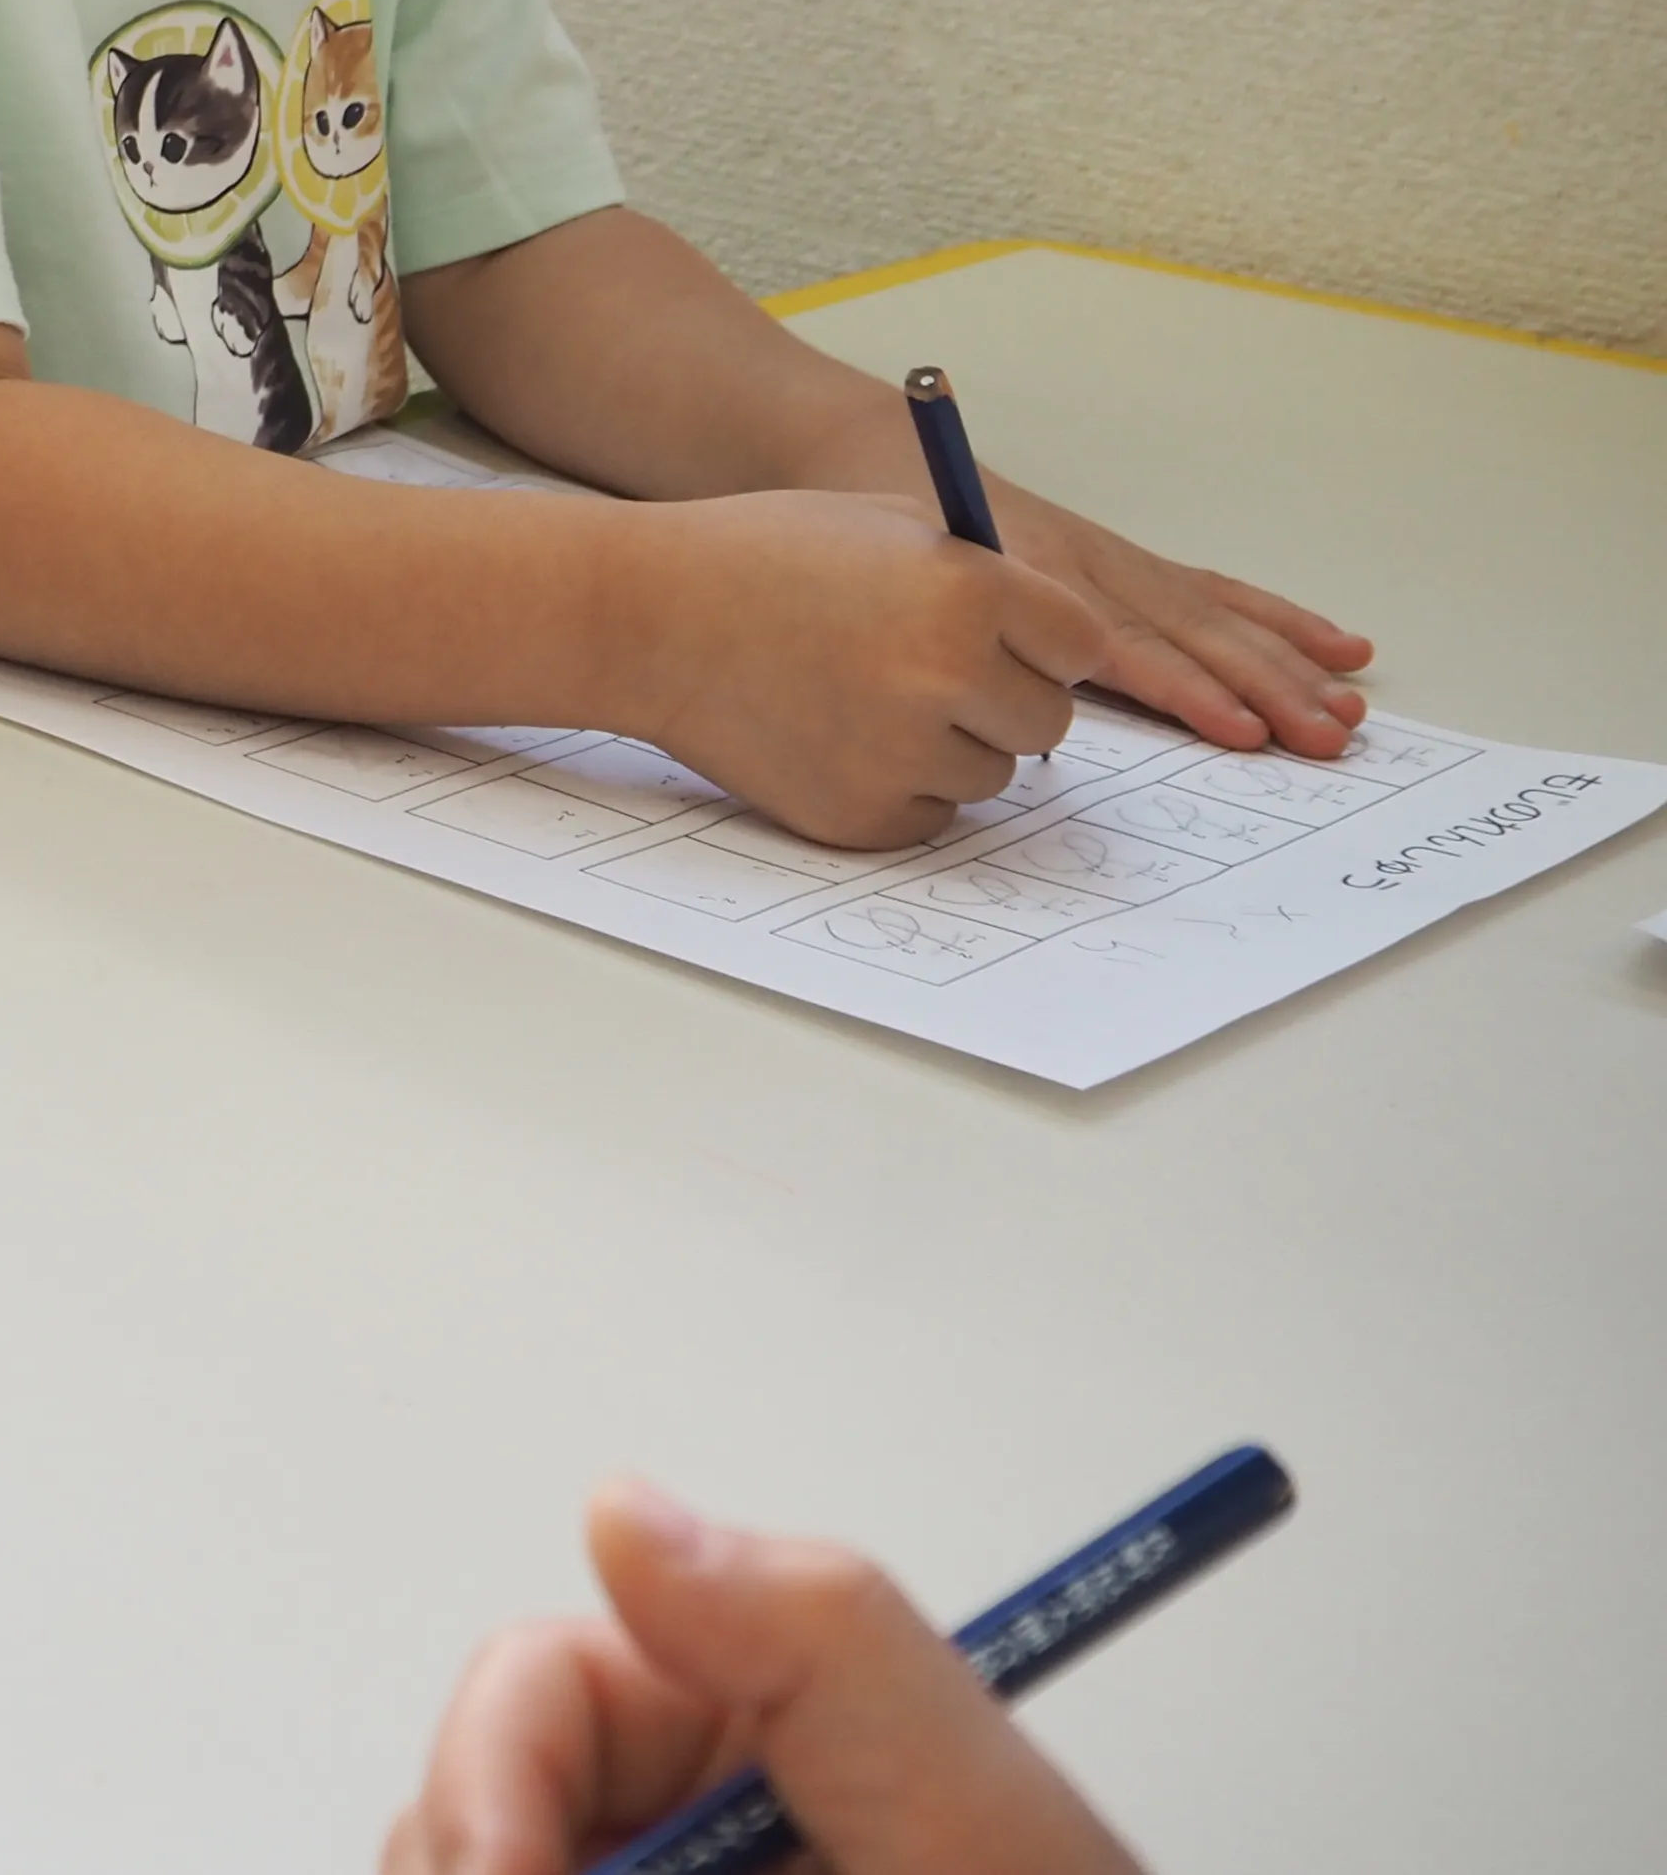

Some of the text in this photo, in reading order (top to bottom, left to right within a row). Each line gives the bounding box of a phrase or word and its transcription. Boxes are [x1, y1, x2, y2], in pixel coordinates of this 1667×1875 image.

[1340, 773, 1603, 891] もじのれんしゅう
